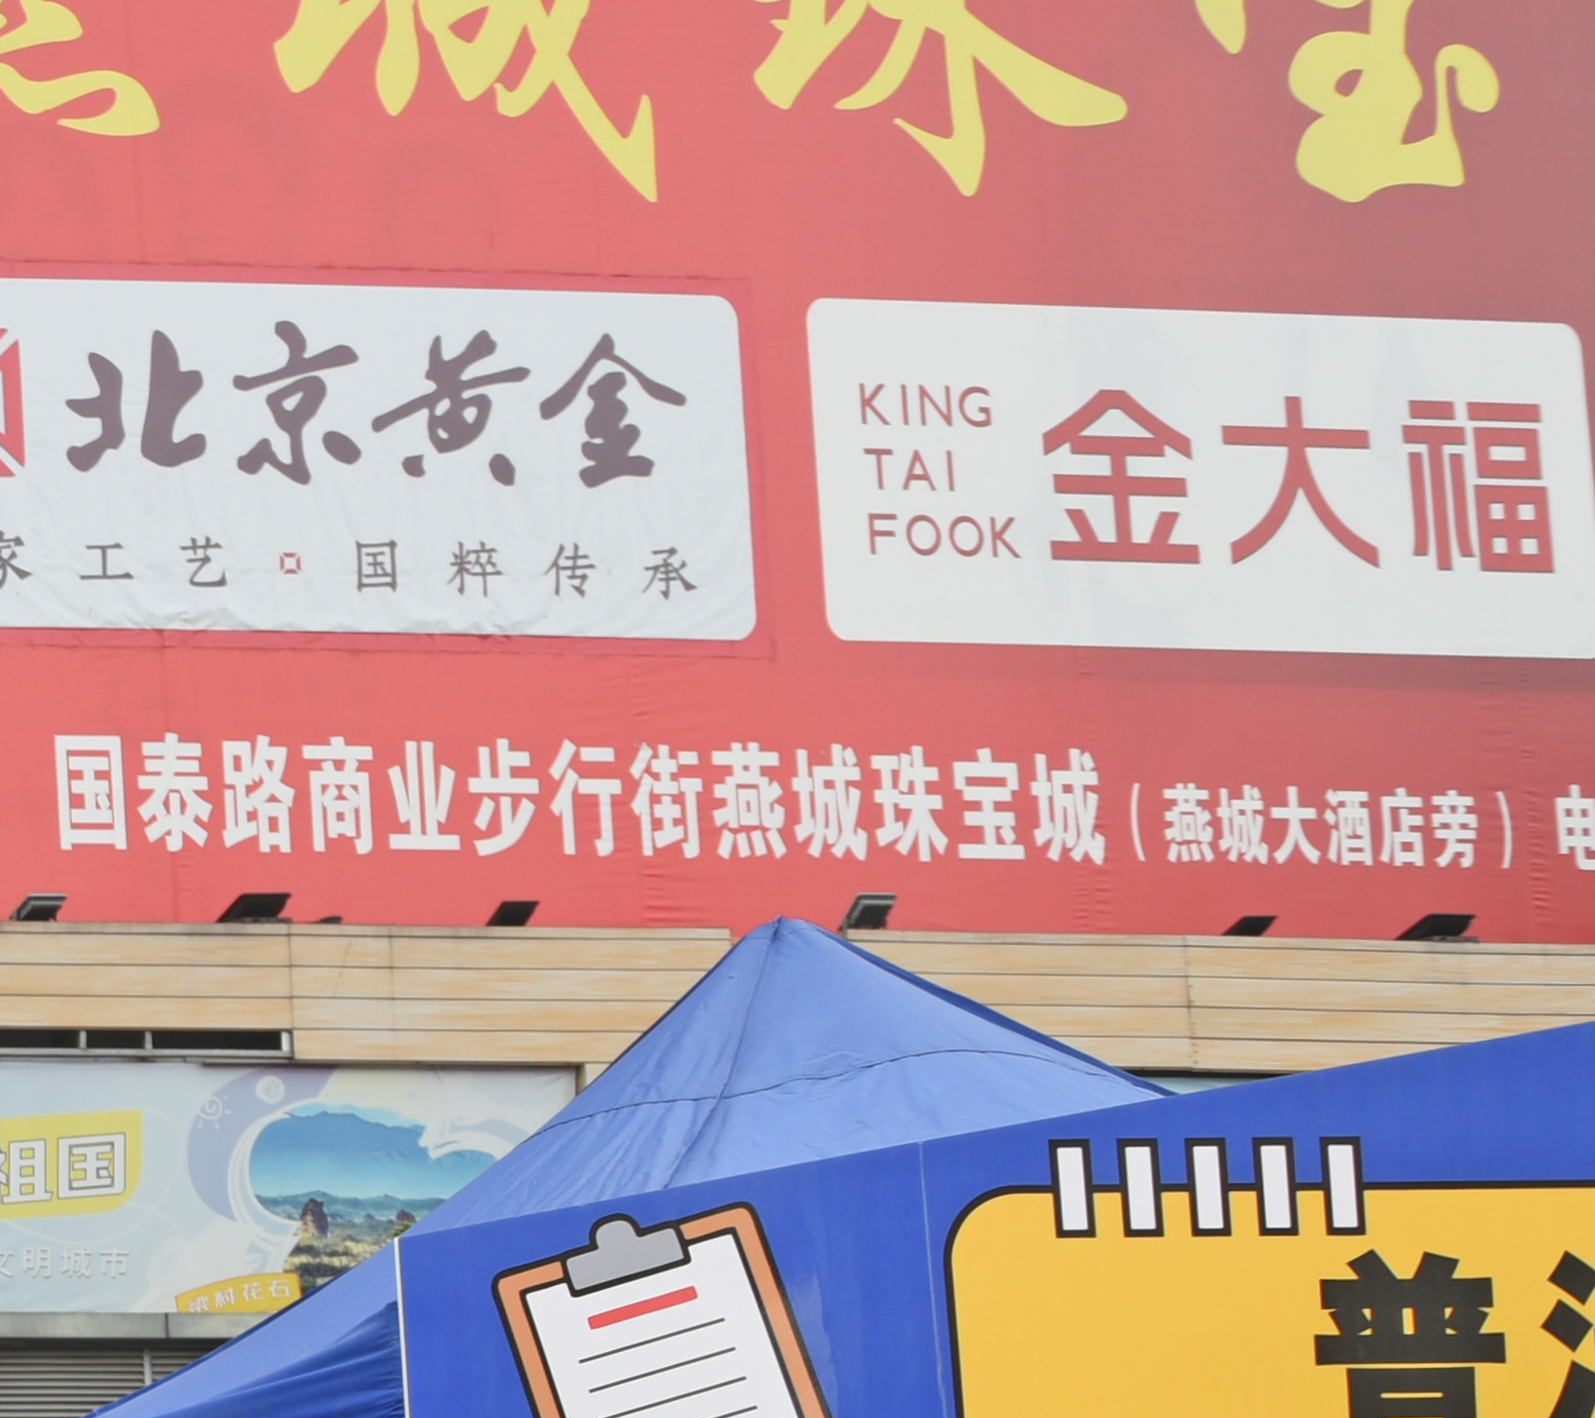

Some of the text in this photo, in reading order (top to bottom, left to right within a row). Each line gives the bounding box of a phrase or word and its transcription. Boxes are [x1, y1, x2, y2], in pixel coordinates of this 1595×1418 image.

[65, 321, 687, 488] 北京黄金
[857, 383, 994, 429] KING
[864, 449, 957, 492] TAI
[1042, 388, 1556, 575] 金大福
[867, 514, 1022, 560] FOOK
[356, 538, 699, 600] 国粹传承
